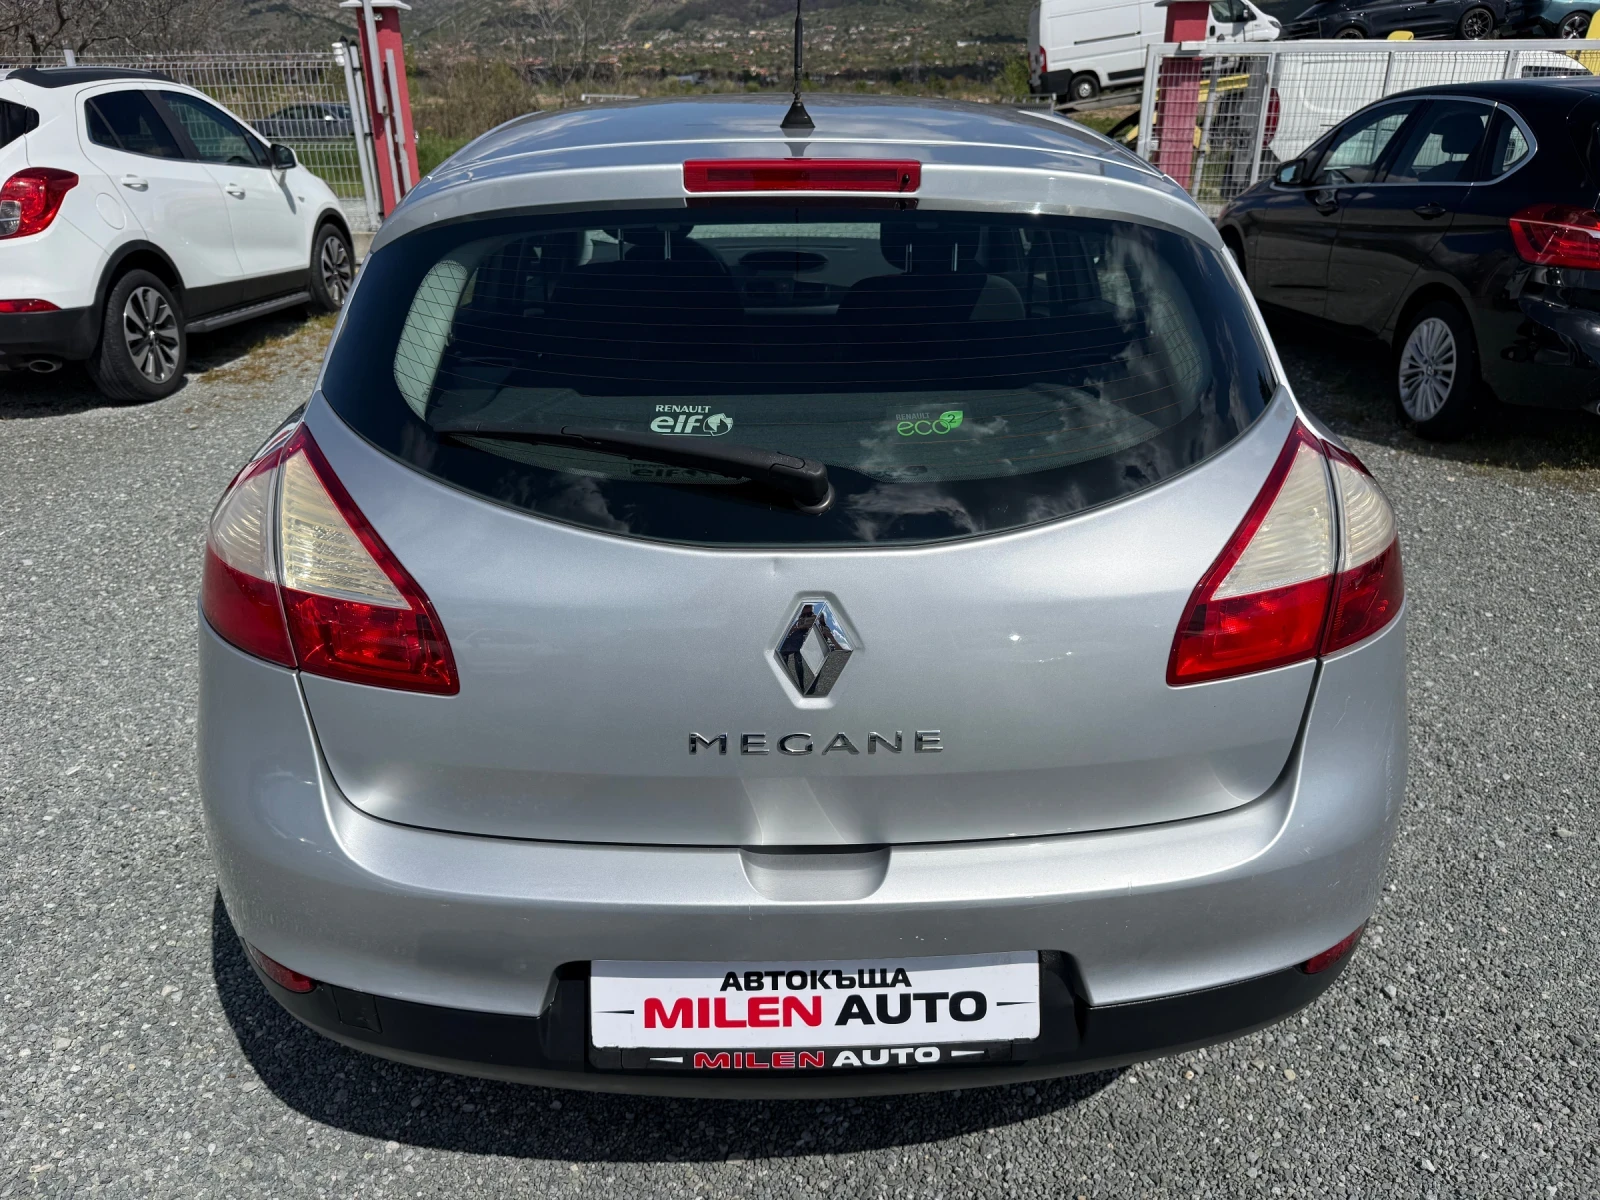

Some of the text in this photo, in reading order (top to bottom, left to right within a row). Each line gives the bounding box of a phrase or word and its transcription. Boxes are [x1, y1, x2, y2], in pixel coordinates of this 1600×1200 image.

[655, 404, 712, 413] RENAULT
[895, 412, 930, 421] RENAULT
[650, 414, 704, 433] elf
[689, 729, 944, 755] MEGANE
[720, 967, 912, 992] АВТОКЪЩА
[643, 991, 988, 1029] MILEN AUTO
[693, 1046, 941, 1069] MILEN AUTO
